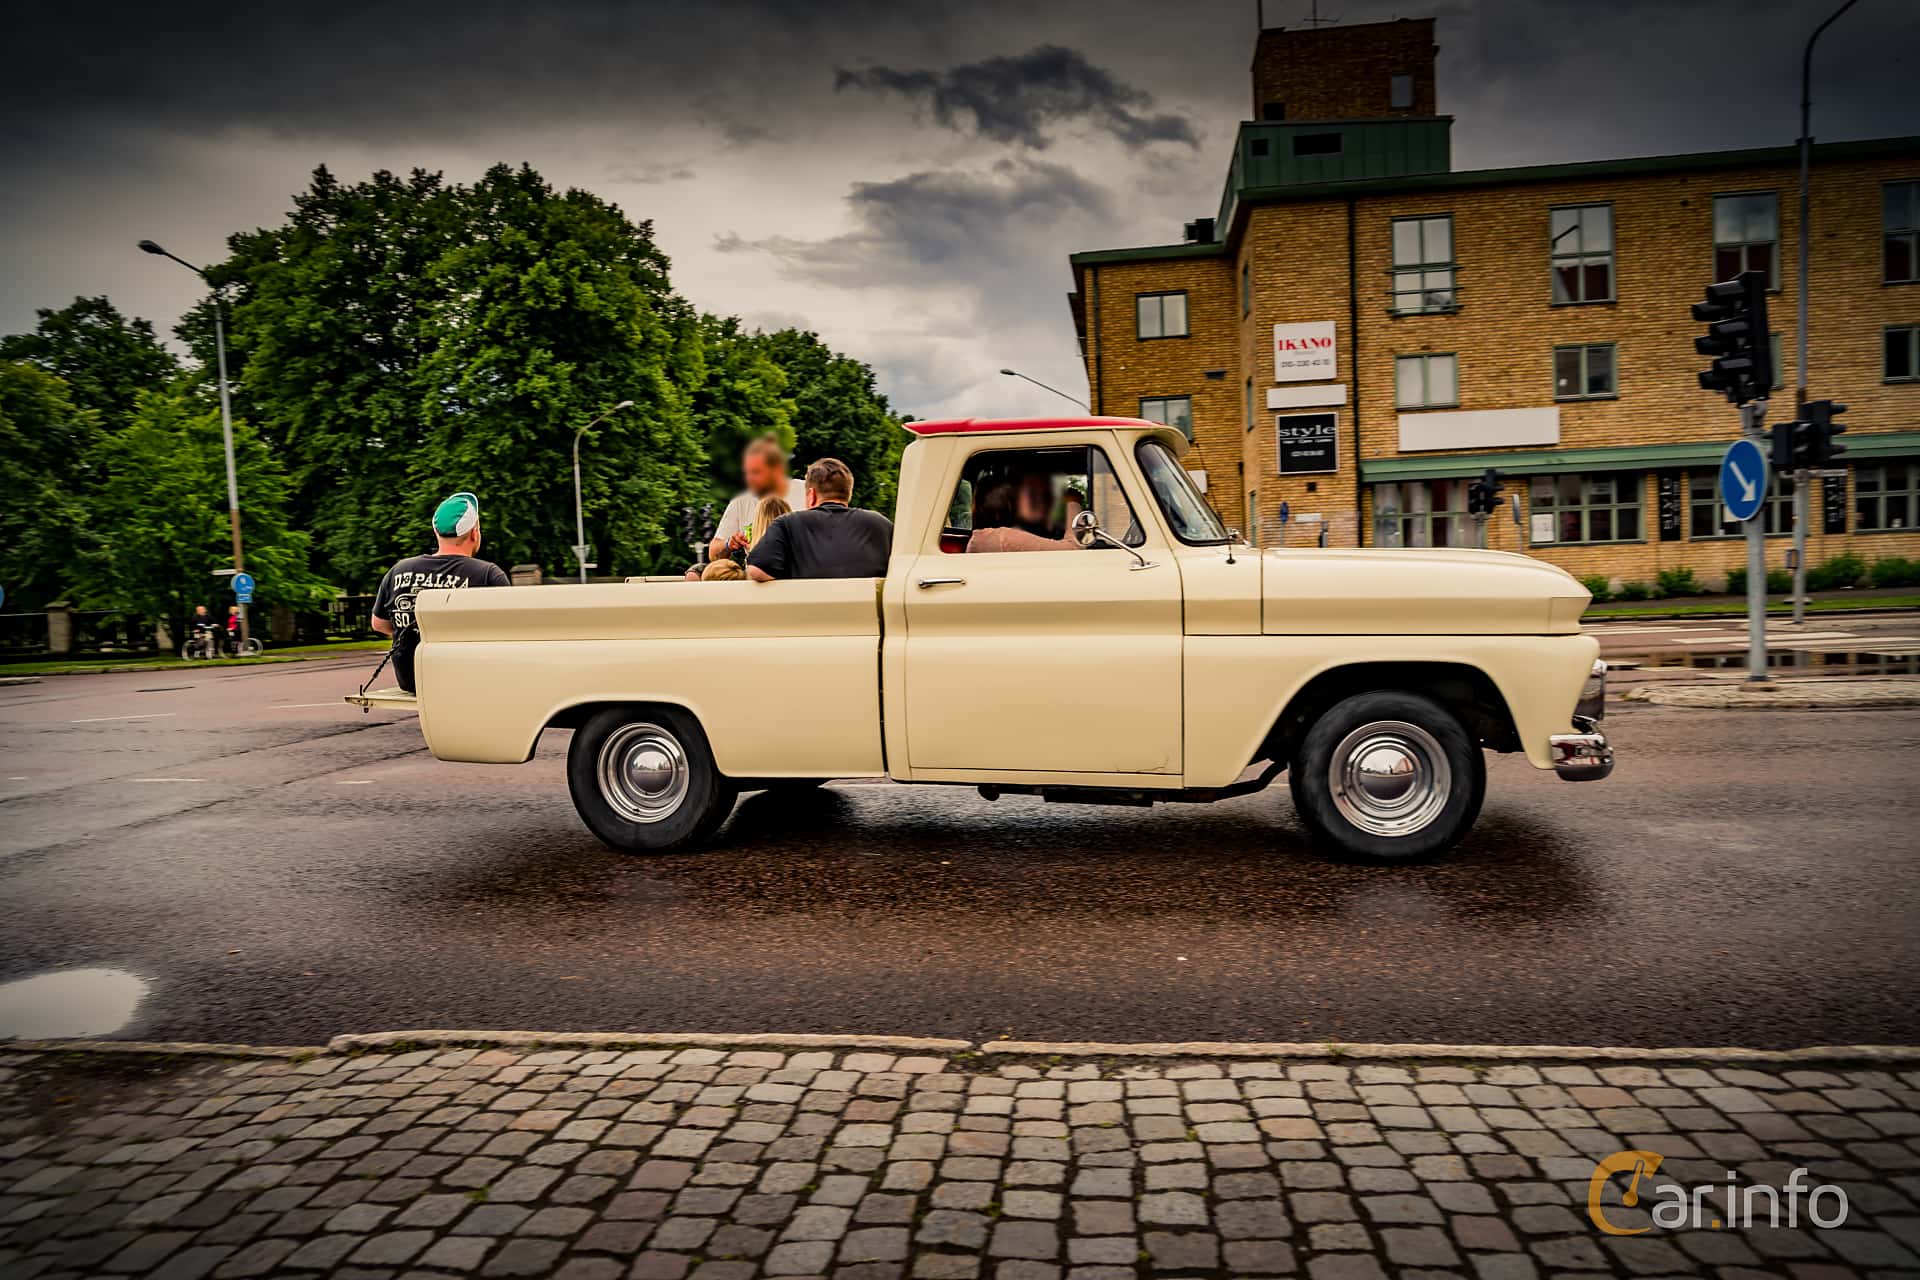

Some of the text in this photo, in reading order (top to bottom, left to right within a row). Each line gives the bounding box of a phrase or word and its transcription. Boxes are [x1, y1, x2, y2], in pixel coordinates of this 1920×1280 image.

[1278, 337, 1332, 350] IKANO
[1279, 424, 1337, 436] style
[393, 572, 469, 591] DE PALMA
